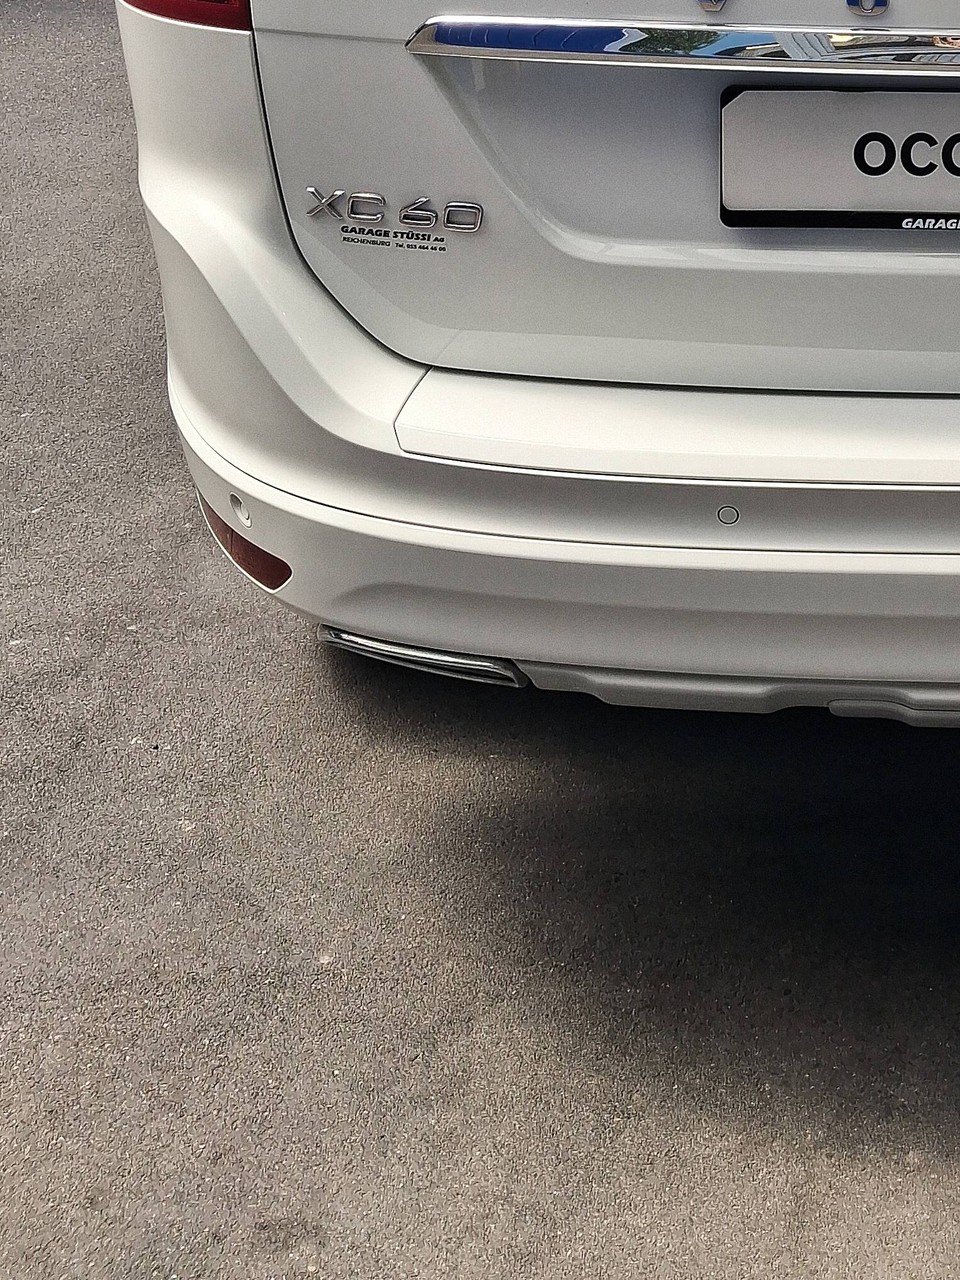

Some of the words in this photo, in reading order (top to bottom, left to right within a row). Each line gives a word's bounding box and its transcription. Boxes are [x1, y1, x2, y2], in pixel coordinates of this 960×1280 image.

[306, 186, 386, 223] XC
[399, 196, 484, 233] 60
[341, 225, 390, 237] GARAGE
[392, 230, 431, 241] STÜSSI
[342, 236, 391, 246] REICHENBURG
